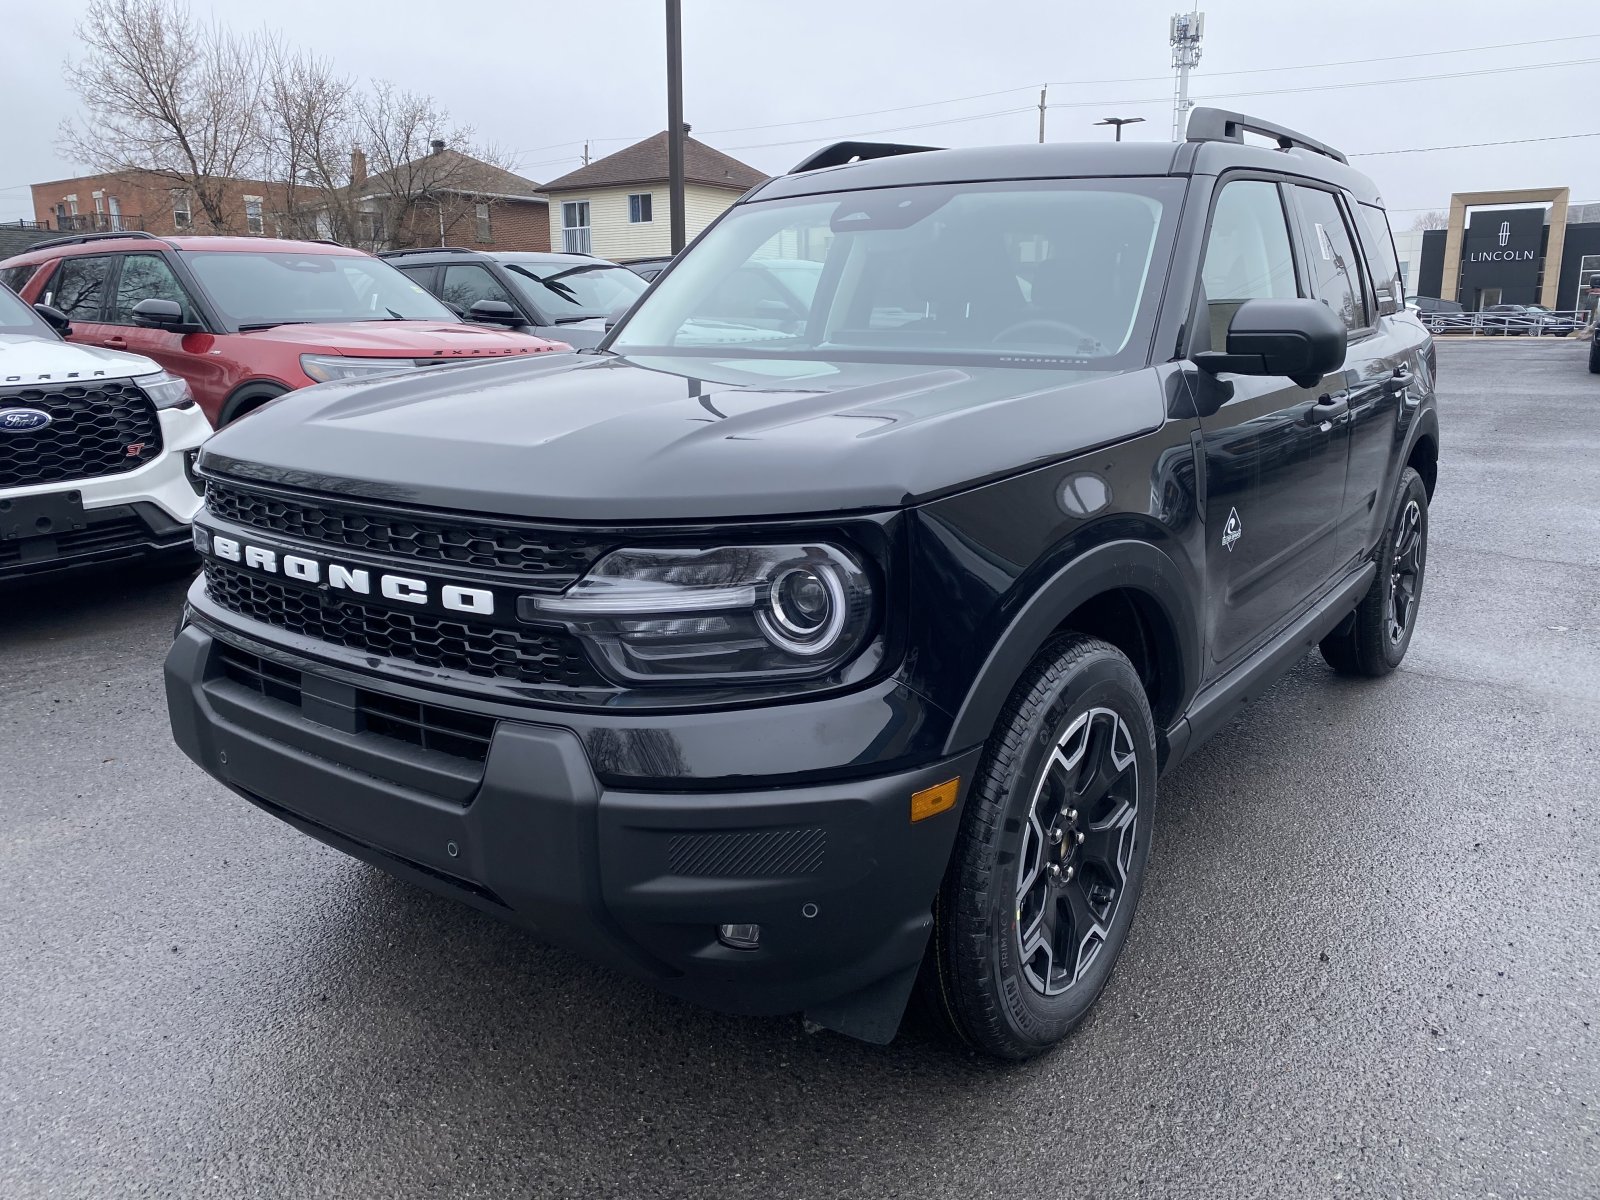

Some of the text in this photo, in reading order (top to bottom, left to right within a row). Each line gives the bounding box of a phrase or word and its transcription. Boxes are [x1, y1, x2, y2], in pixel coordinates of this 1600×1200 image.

[1471, 250, 1534, 262] LINCOLN
[4, 414, 39, 427] Ford
[126, 442, 145, 457] ST
[213, 535, 494, 615] BRONCO
[1001, 909, 1009, 968] PRIMACY
